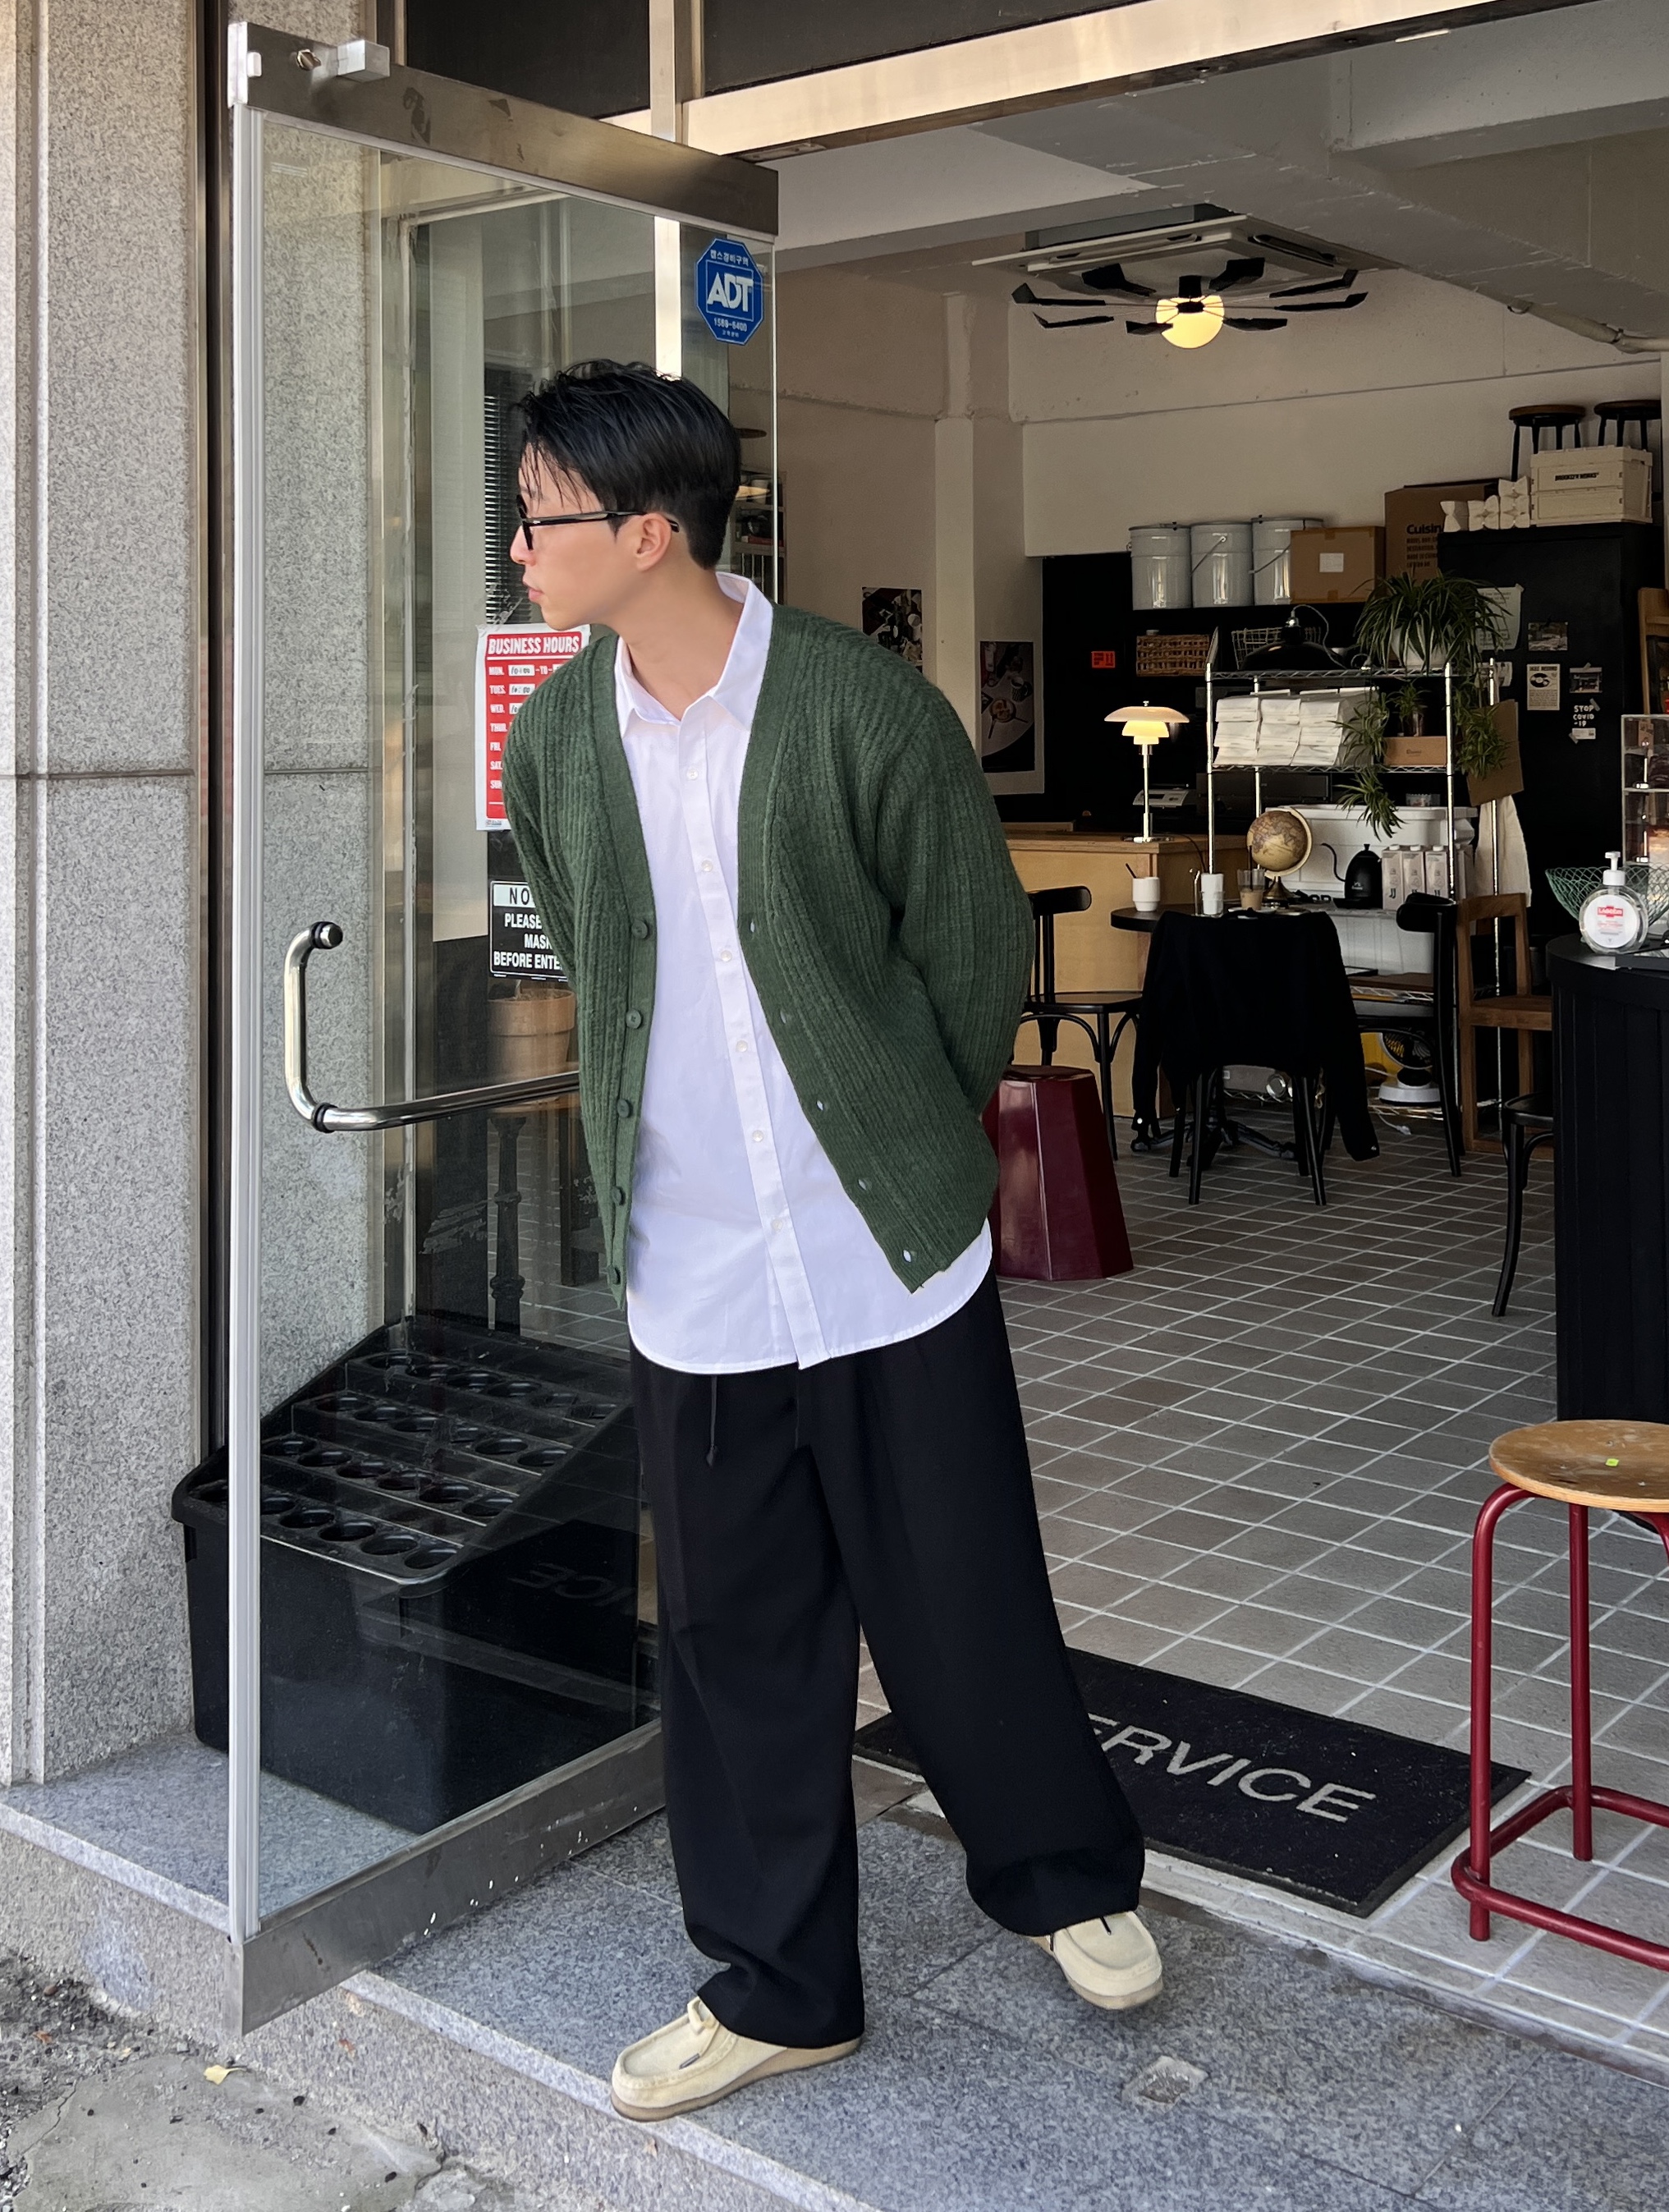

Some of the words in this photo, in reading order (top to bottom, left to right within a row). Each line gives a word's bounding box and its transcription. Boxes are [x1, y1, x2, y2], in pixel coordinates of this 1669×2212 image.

[707, 272, 754, 312] ADT
[1406, 523, 1443, 535] Cuisin
[488, 637, 541, 654] BUSINESS
[543, 636, 580, 653] HOURS
[1574, 704, 1594, 713] STOP
[504, 912, 543, 929] PLEASE
[493, 950, 533, 969] BEFORE
[534, 953, 563, 971] ENTE
[1087, 1712, 1376, 1823] RVICE
